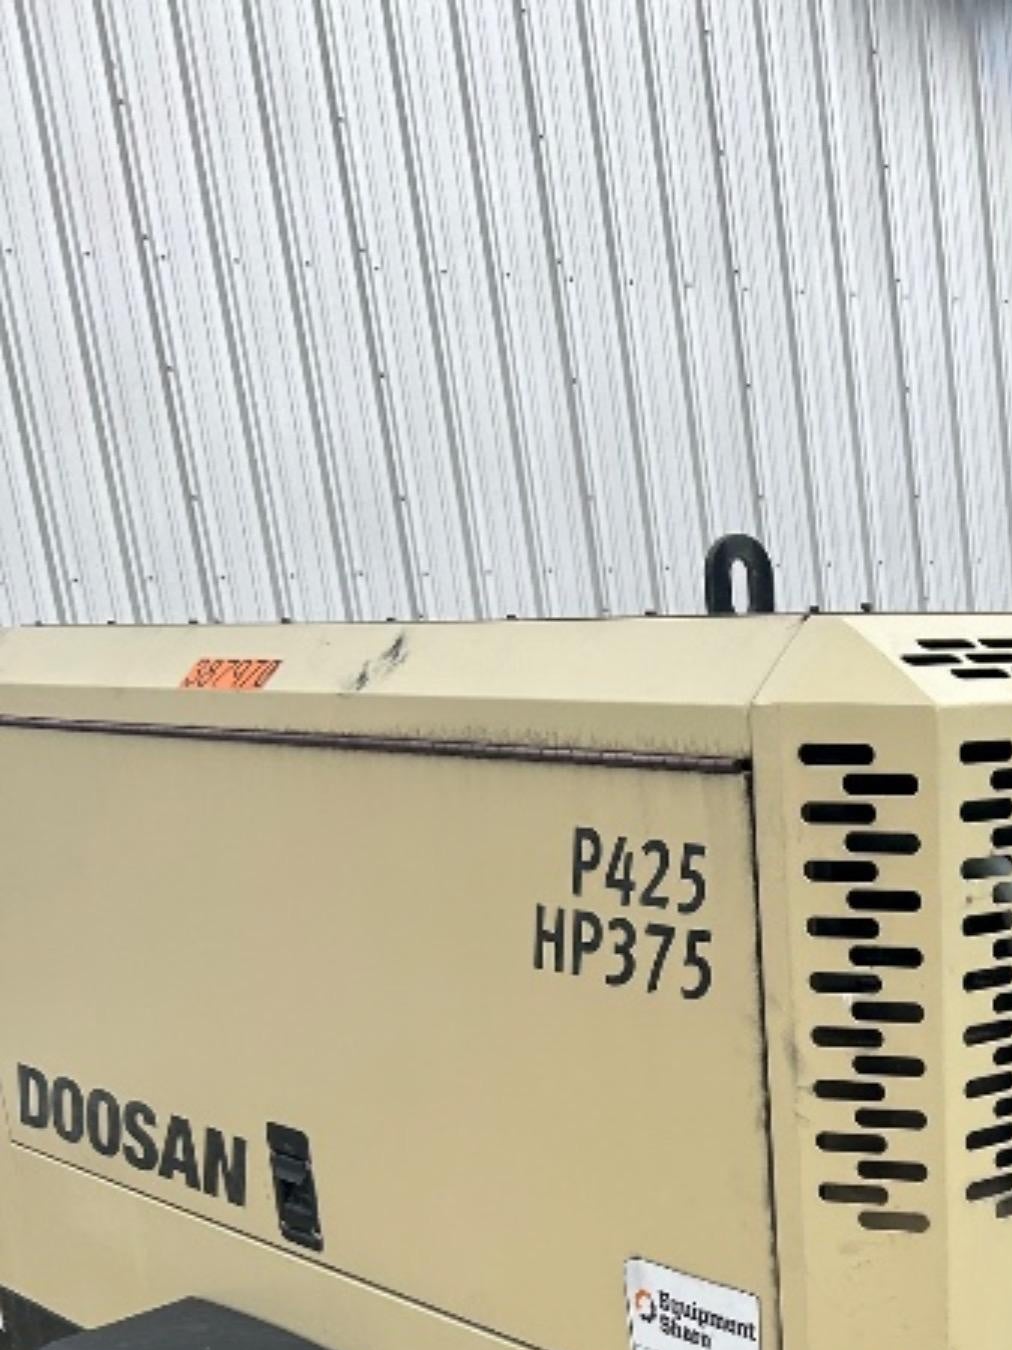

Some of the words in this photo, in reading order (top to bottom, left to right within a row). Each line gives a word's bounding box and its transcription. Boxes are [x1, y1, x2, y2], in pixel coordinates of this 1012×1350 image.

[183, 658, 283, 689] 387970
[572, 826, 706, 914] P425
[533, 902, 712, 1000] HP375
[17, 1062, 247, 1207] DOOSAN
[658, 1289, 757, 1342] Equipment
